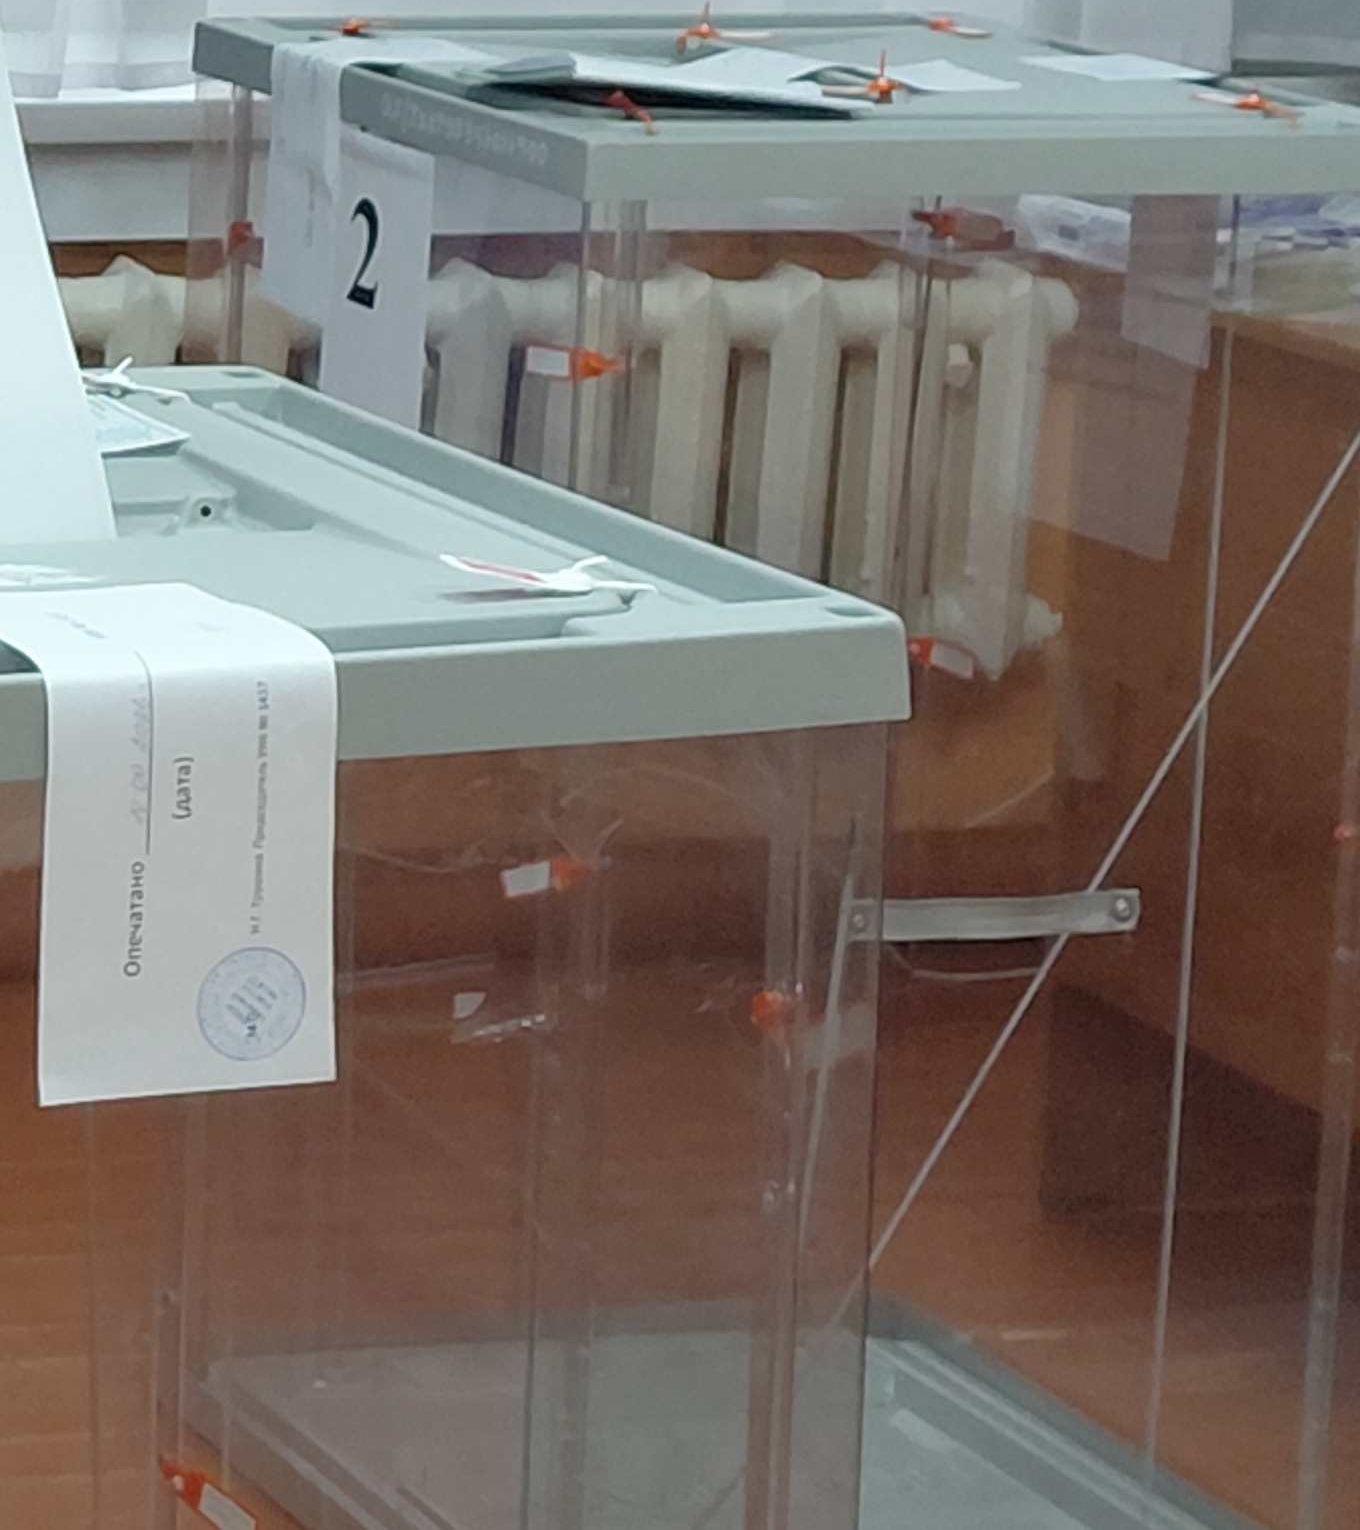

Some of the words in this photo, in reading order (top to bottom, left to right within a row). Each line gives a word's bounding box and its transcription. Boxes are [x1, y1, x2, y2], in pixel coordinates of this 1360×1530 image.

[345, 197, 381, 310] 2
[171, 756, 195, 820] (дата)
[122, 860, 146, 978] Опечатано
